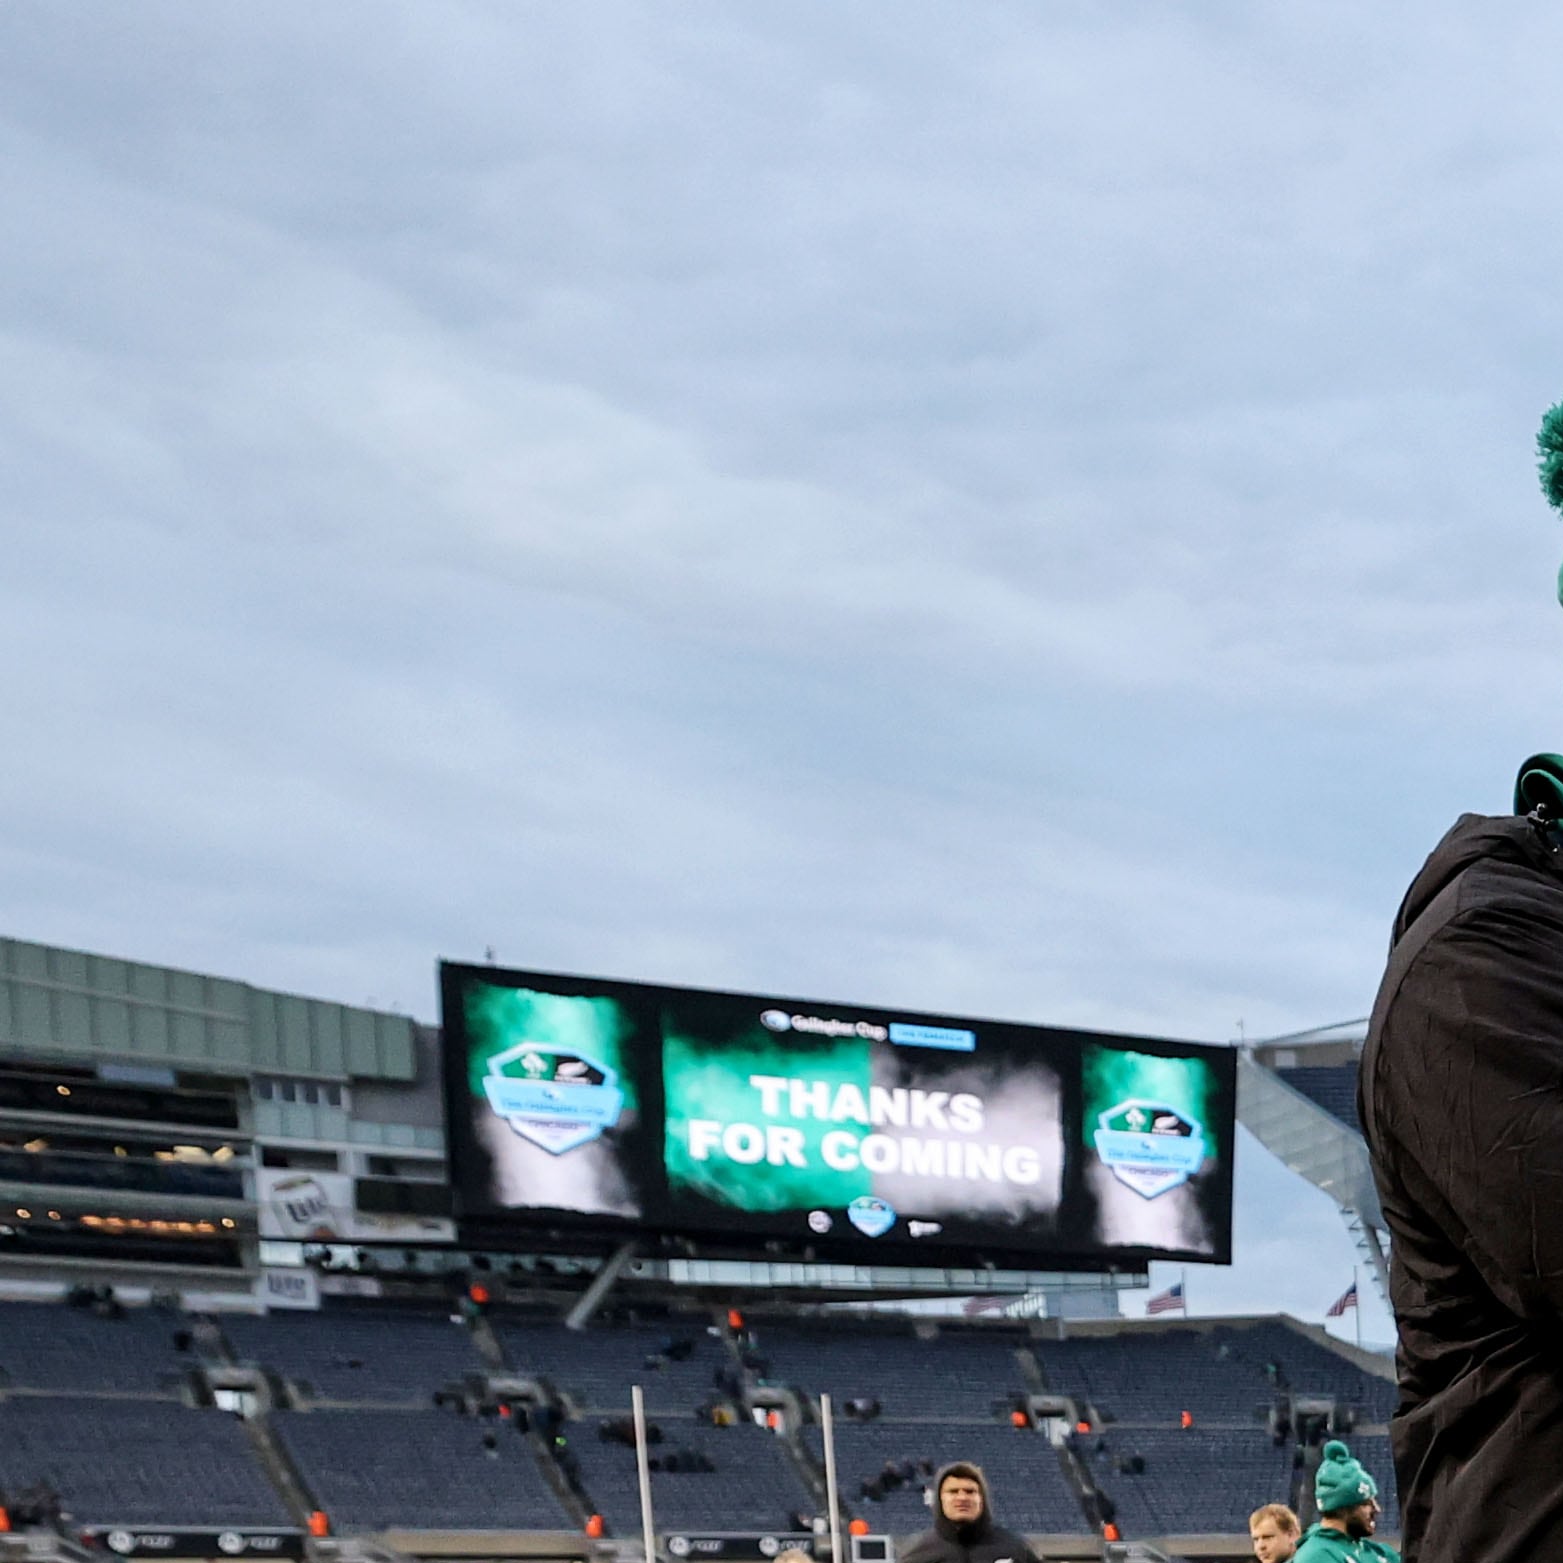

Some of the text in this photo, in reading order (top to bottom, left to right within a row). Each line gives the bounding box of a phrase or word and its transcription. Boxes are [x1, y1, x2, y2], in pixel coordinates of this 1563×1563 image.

[749, 1073, 985, 1134] THANKS
[687, 1118, 1042, 1185] FOR COMING
